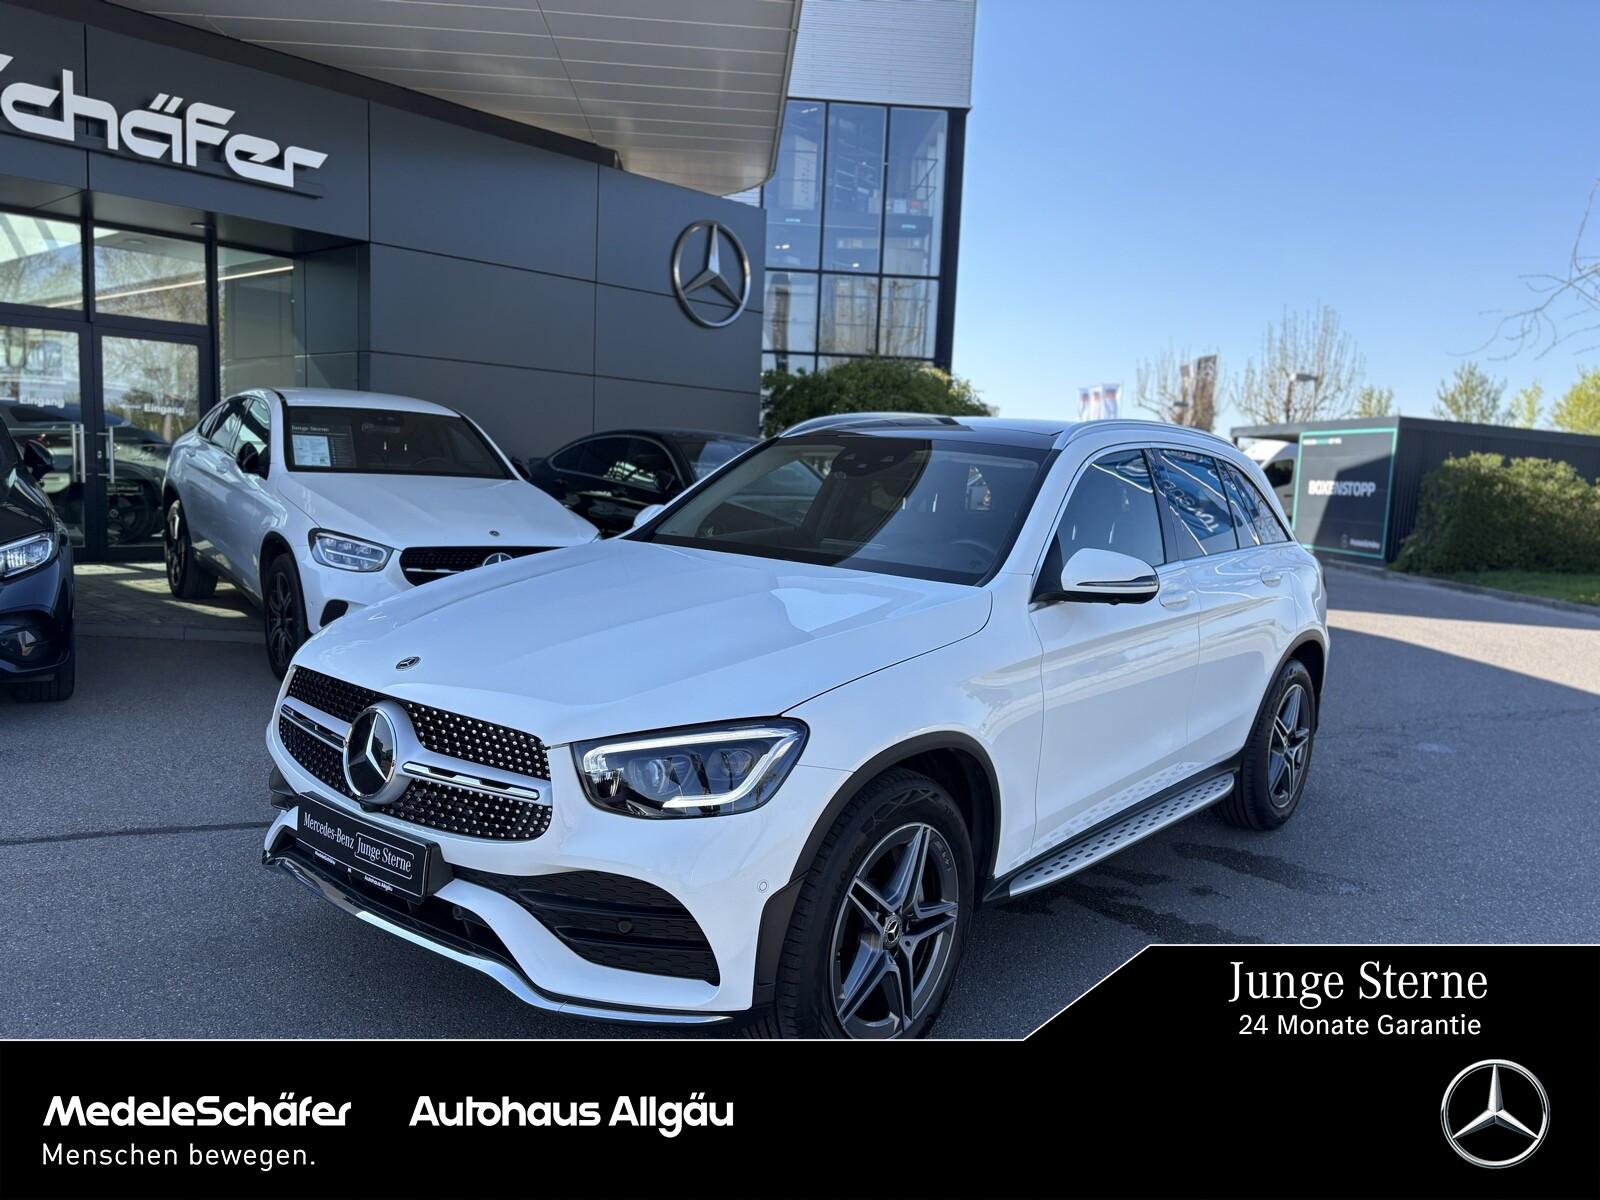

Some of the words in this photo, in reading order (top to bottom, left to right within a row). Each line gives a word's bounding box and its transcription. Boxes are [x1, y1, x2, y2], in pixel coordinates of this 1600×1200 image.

[0, 54, 328, 188] chäfer
[19, 396, 65, 409] Eingang
[143, 403, 185, 416] Eingang
[1308, 480, 1376, 497] BOXENSTOPP
[303, 811, 354, 849] Mercedes-Benz
[356, 837, 381, 861] Junge
[382, 847, 412, 873] Sterne
